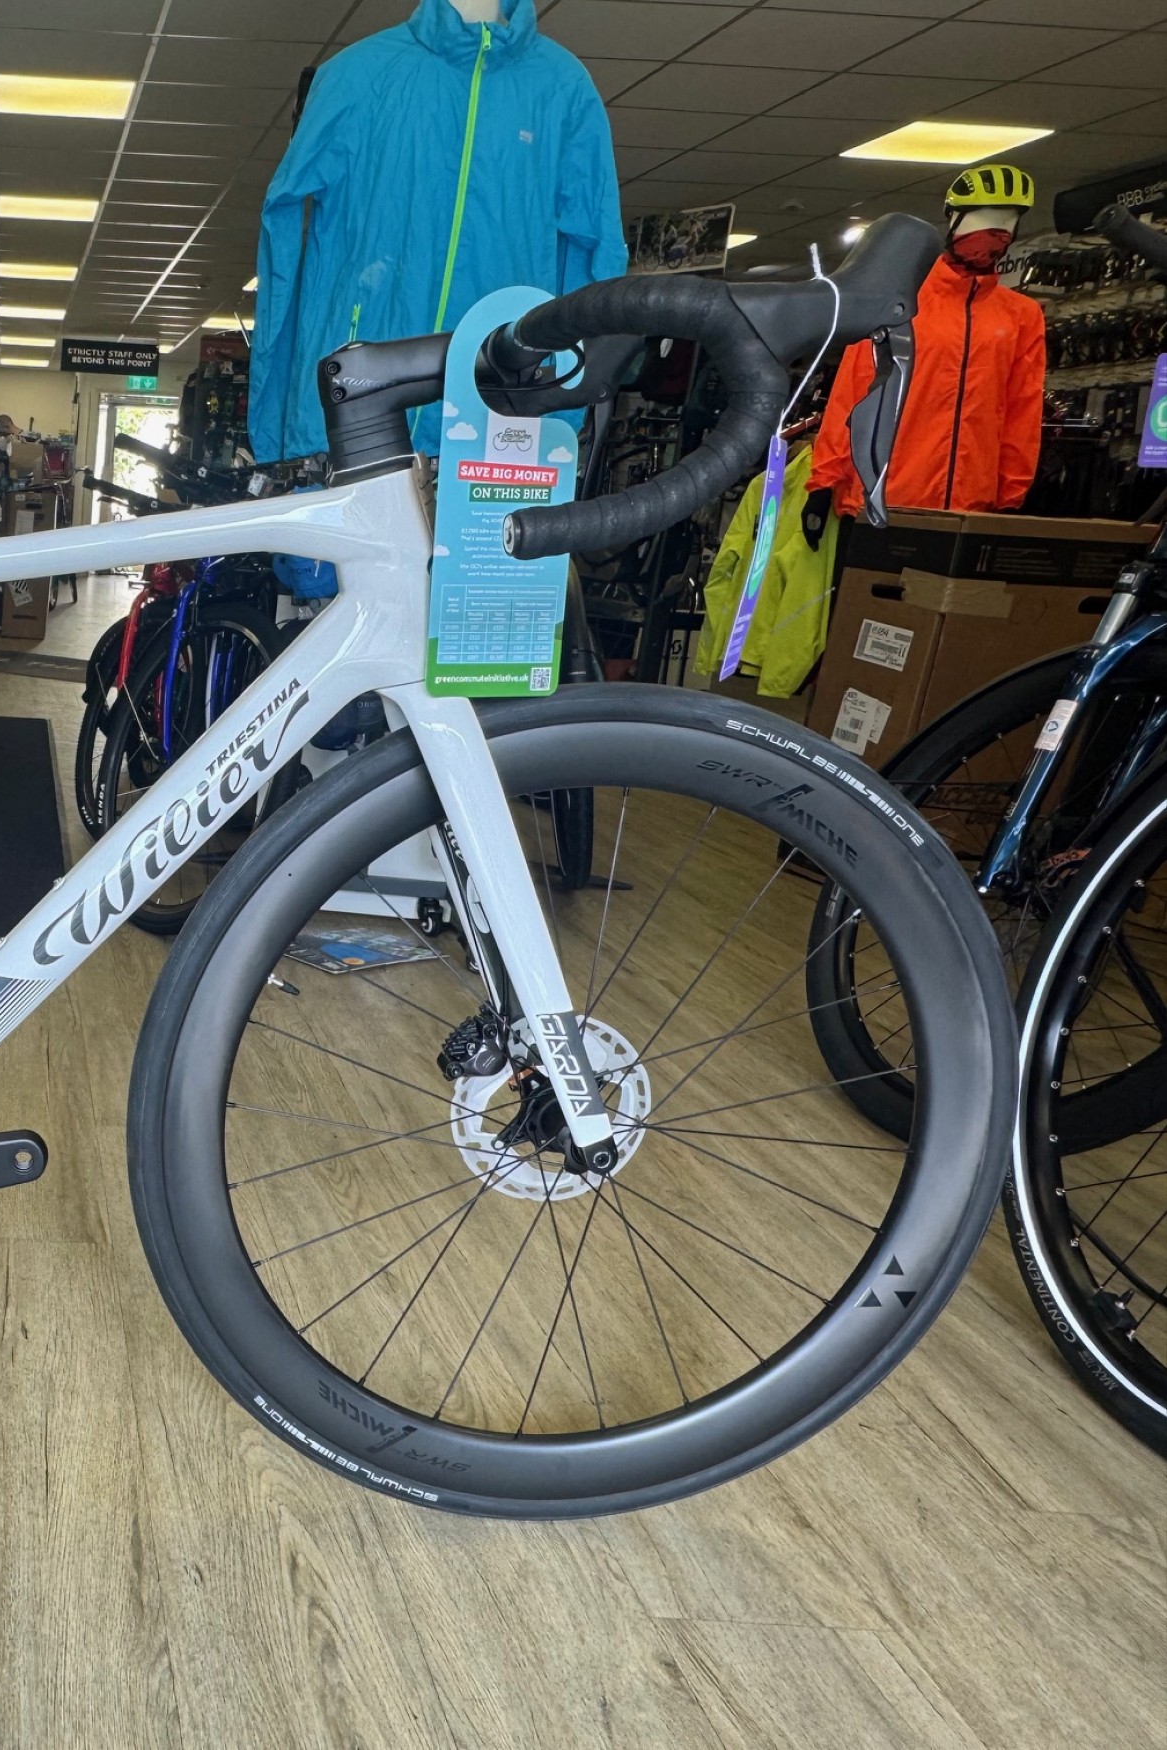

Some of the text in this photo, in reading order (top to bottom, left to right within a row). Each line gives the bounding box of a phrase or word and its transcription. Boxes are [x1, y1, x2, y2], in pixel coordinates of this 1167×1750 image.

[996, 250, 1026, 274] abri
[67, 347, 158, 360] STRICTLY STAFF ONLY
[71, 356, 153, 368] BEYOND THIS POINT
[460, 465, 556, 483] SAVE BIG MONEY
[472, 487, 550, 500] ON THIS BIKE
[205, 677, 302, 778] TRIESTINA
[725, 719, 926, 848] SCHWALBE ONE
[32, 689, 310, 966] Wilier
[779, 802, 859, 869] MICHE
[535, 1014, 592, 1118] GARDA
[1015, 1226, 1077, 1345] CONTINENTAL
[318, 1379, 396, 1438] MICHE
[335, 1455, 439, 1503] SCHWALBE
